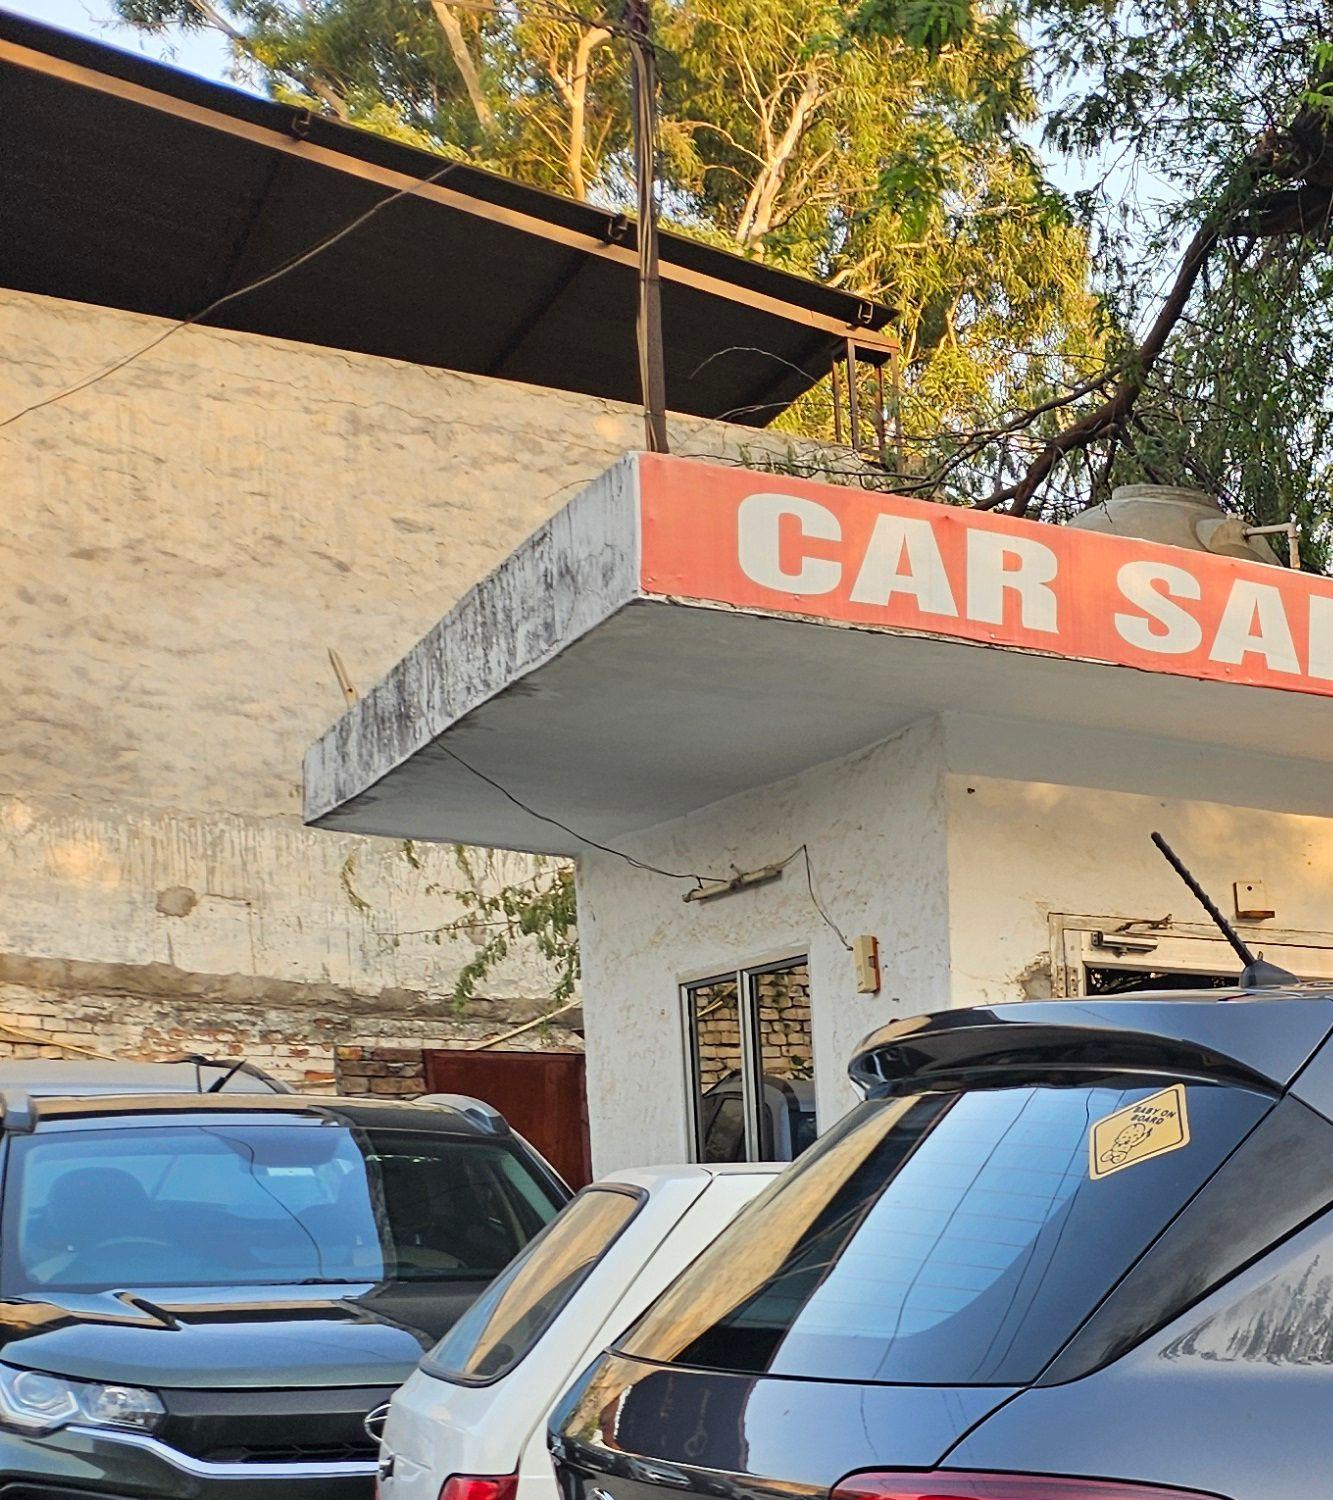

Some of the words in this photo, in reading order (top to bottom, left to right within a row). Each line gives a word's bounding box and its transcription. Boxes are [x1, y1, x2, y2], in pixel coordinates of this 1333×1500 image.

[737, 493, 1059, 634] CAR
[1133, 1106, 1160, 1115] BABY
[1160, 1109, 1177, 1118] ON
[1131, 1114, 1164, 1125] BOARD
